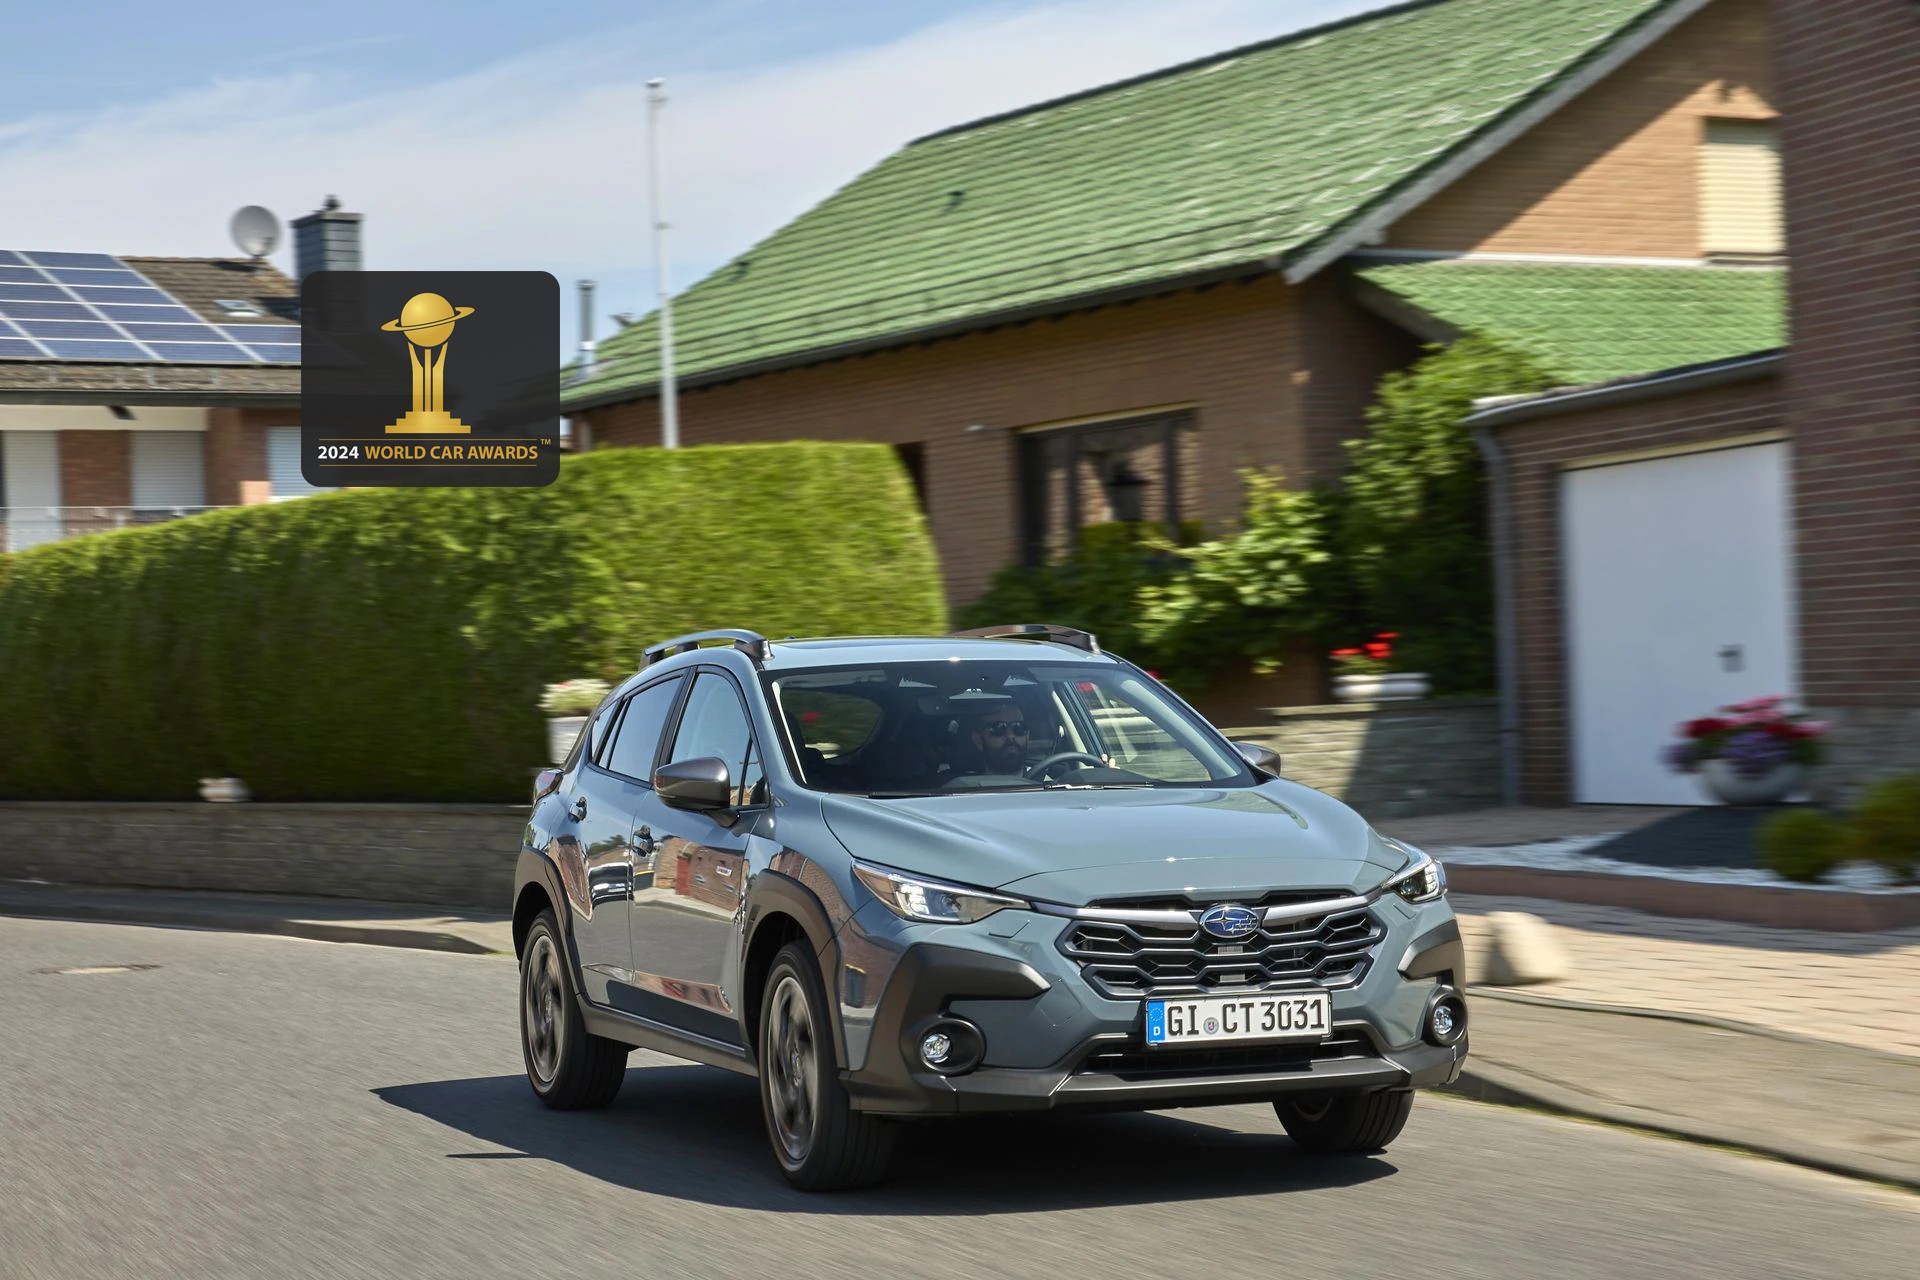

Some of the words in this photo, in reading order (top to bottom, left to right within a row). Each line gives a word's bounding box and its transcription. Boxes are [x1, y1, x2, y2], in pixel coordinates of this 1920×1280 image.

[1167, 1005, 1200, 1036] GI
[1222, 1002, 1255, 1033] CT
[1260, 999, 1325, 1031] 3031
[1153, 1026, 1161, 1036] D
